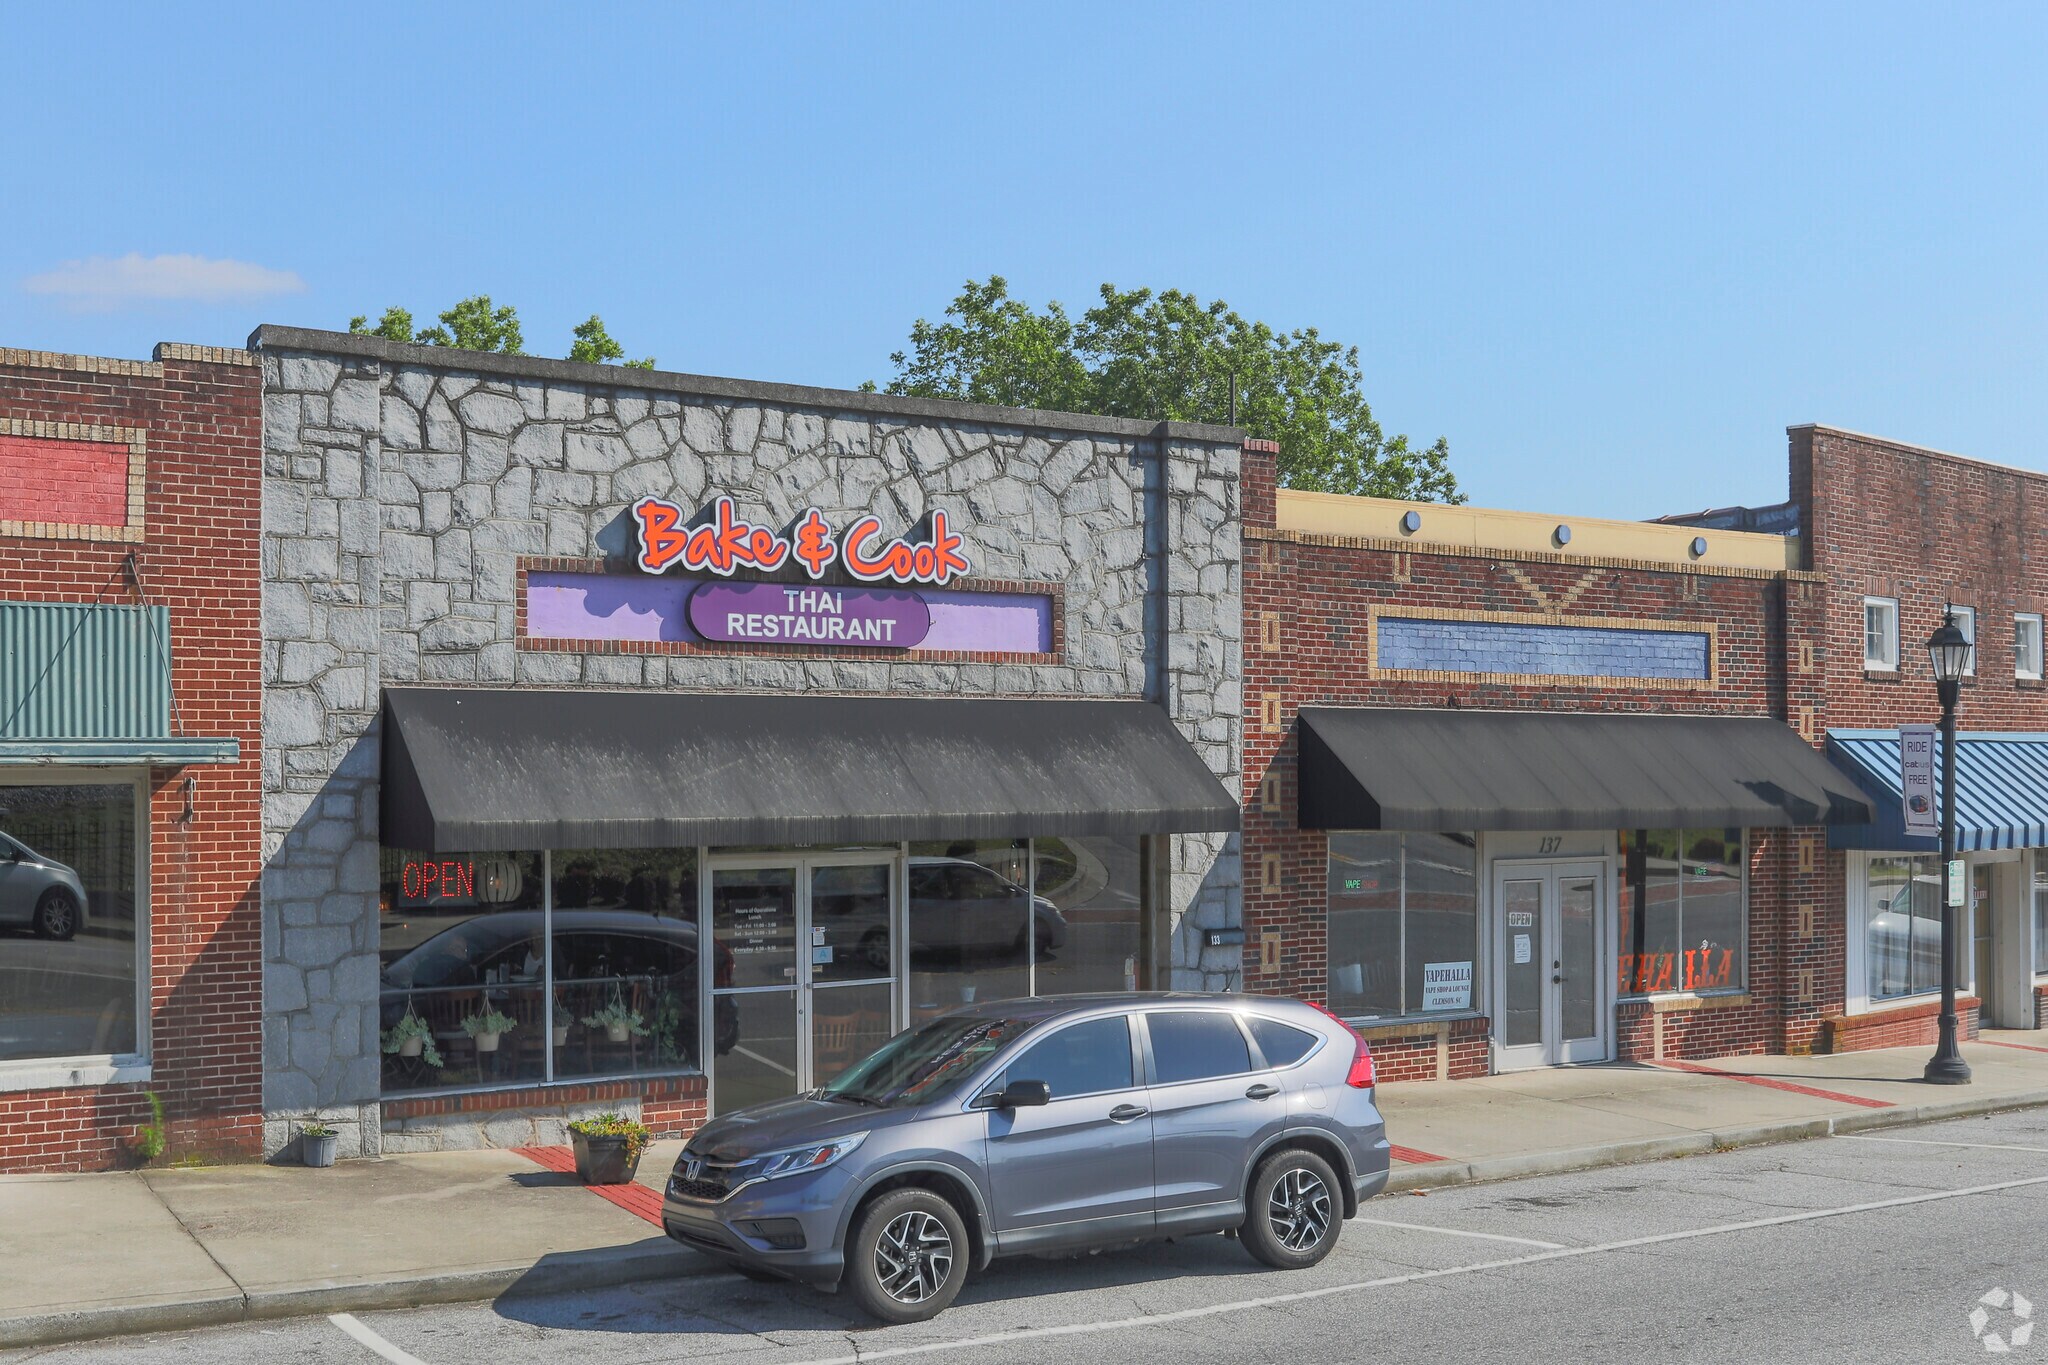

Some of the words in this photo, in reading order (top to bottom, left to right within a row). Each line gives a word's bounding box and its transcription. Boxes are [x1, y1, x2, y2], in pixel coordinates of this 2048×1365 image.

[634, 496, 790, 576] Bake
[793, 507, 838, 580] &
[842, 509, 971, 586] Cook
[783, 590, 842, 614] THAI
[727, 612, 897, 642] RESTAURANT
[1907, 742, 1928, 753] RIDE
[1904, 760, 1930, 768] catus
[1908, 775, 1928, 785] FREE
[1539, 836, 1562, 854] 137
[402, 861, 474, 899] OPEN
[1345, 879, 1361, 889] VAPE
[1510, 913, 1530, 926] OPEN
[1211, 935, 1220, 945] 133
[1425, 968, 1470, 982] VAPEHALLA
[1426, 986, 1436, 994] VAPE
[1453, 984, 1470, 992] LOUNGE
